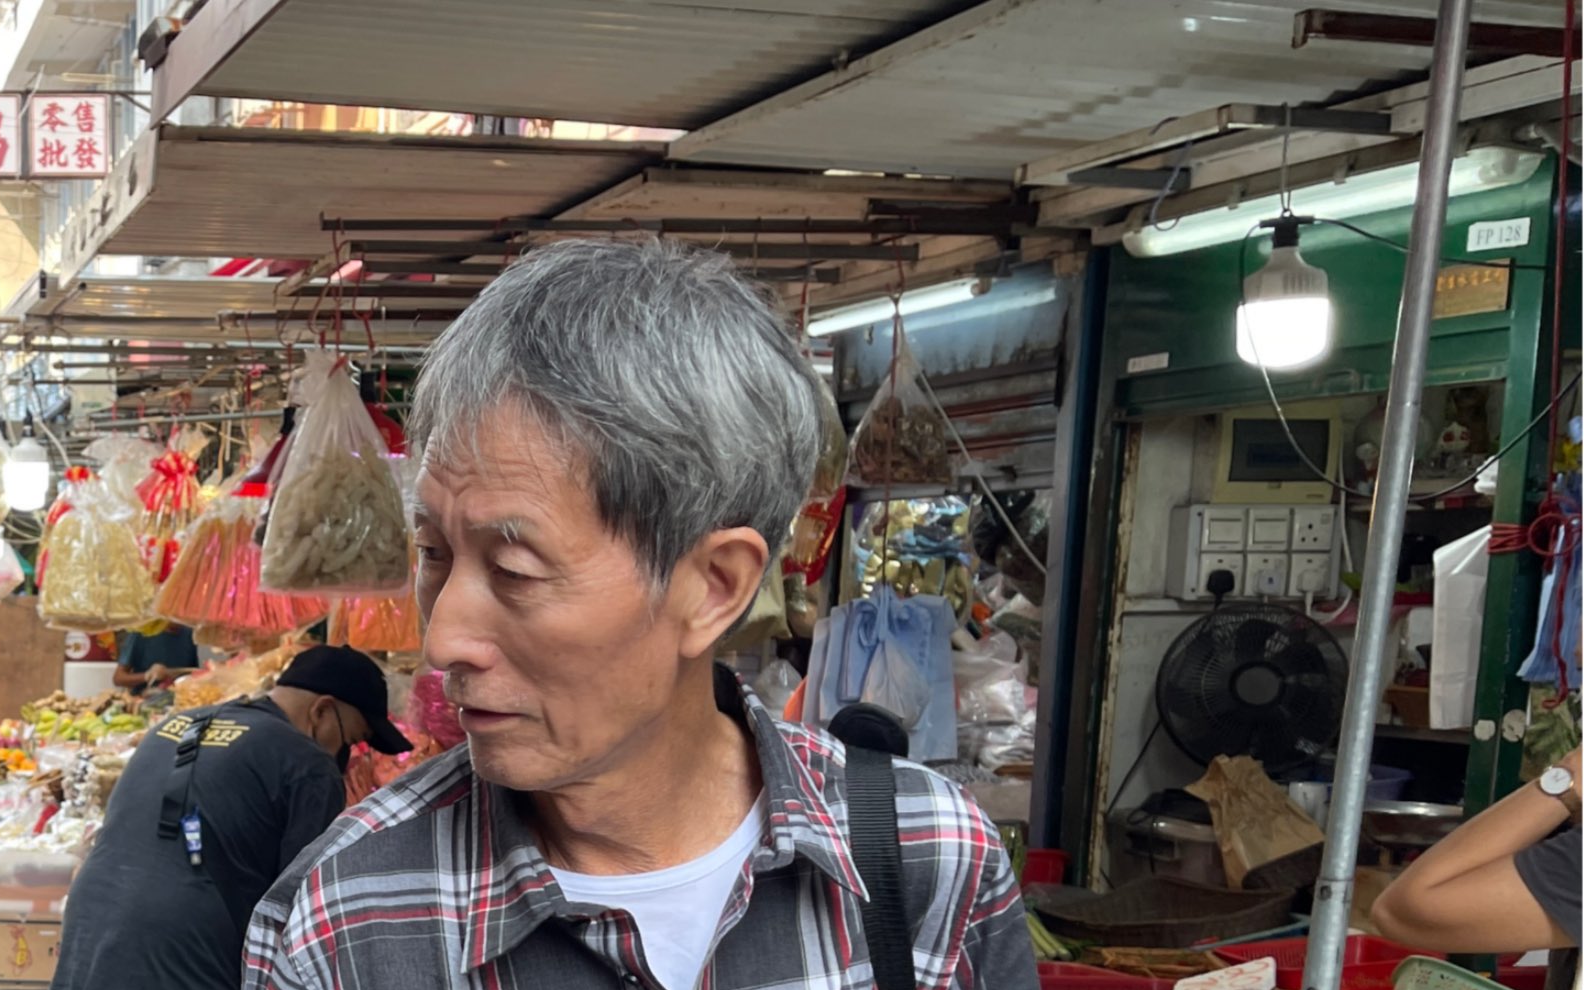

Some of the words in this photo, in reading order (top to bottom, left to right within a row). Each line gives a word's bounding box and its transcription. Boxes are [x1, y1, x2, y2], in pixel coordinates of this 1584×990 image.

[41, 100, 97, 133] 零售
[38, 138, 103, 169] 批發
[1477, 228, 1495, 246] FP
[1498, 225, 1522, 244] 128
